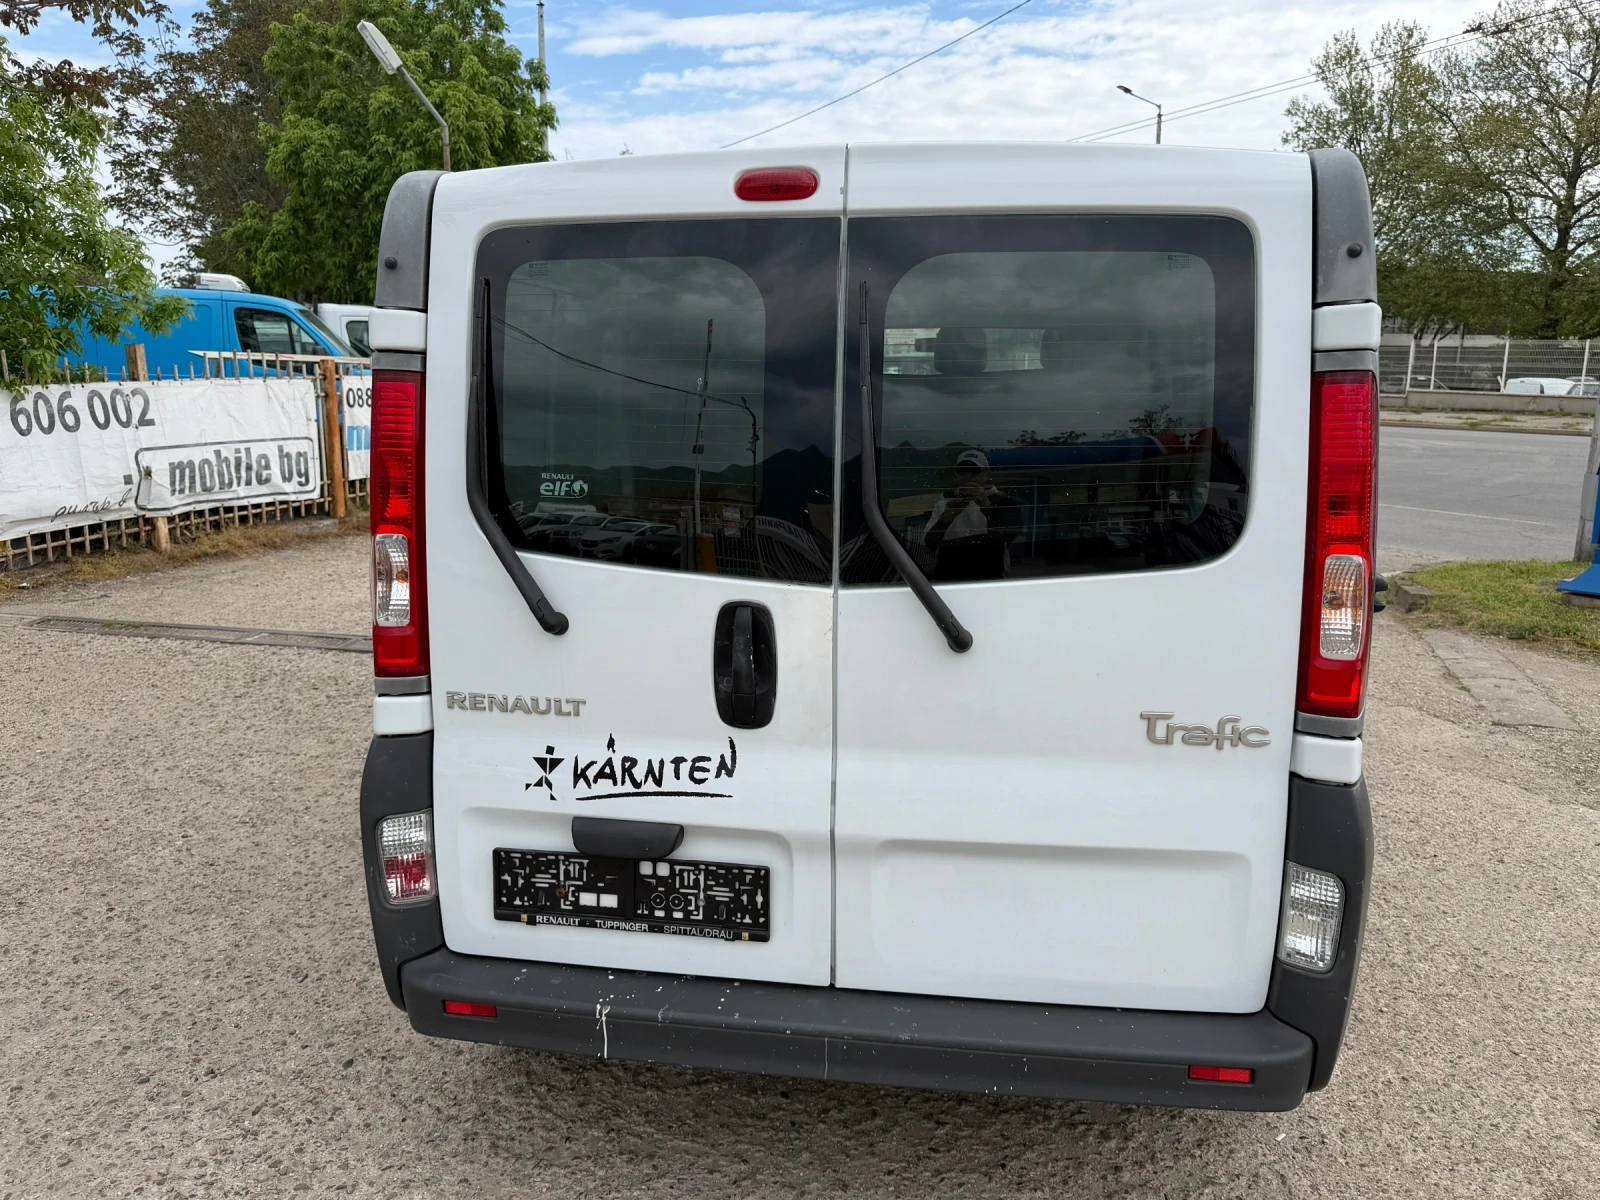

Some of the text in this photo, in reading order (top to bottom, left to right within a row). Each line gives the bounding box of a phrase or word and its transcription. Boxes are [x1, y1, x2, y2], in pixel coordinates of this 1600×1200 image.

[9, 387, 156, 437] 606 002
[168, 447, 272, 497] mobile
[541, 472, 574, 480] RENAULT
[540, 481, 571, 496] elf
[446, 690, 587, 717] RENAULT
[1139, 711, 1271, 750] Trafic
[535, 914, 734, 940] RENAULT TUPPINGER SPITTAL/DRAU
